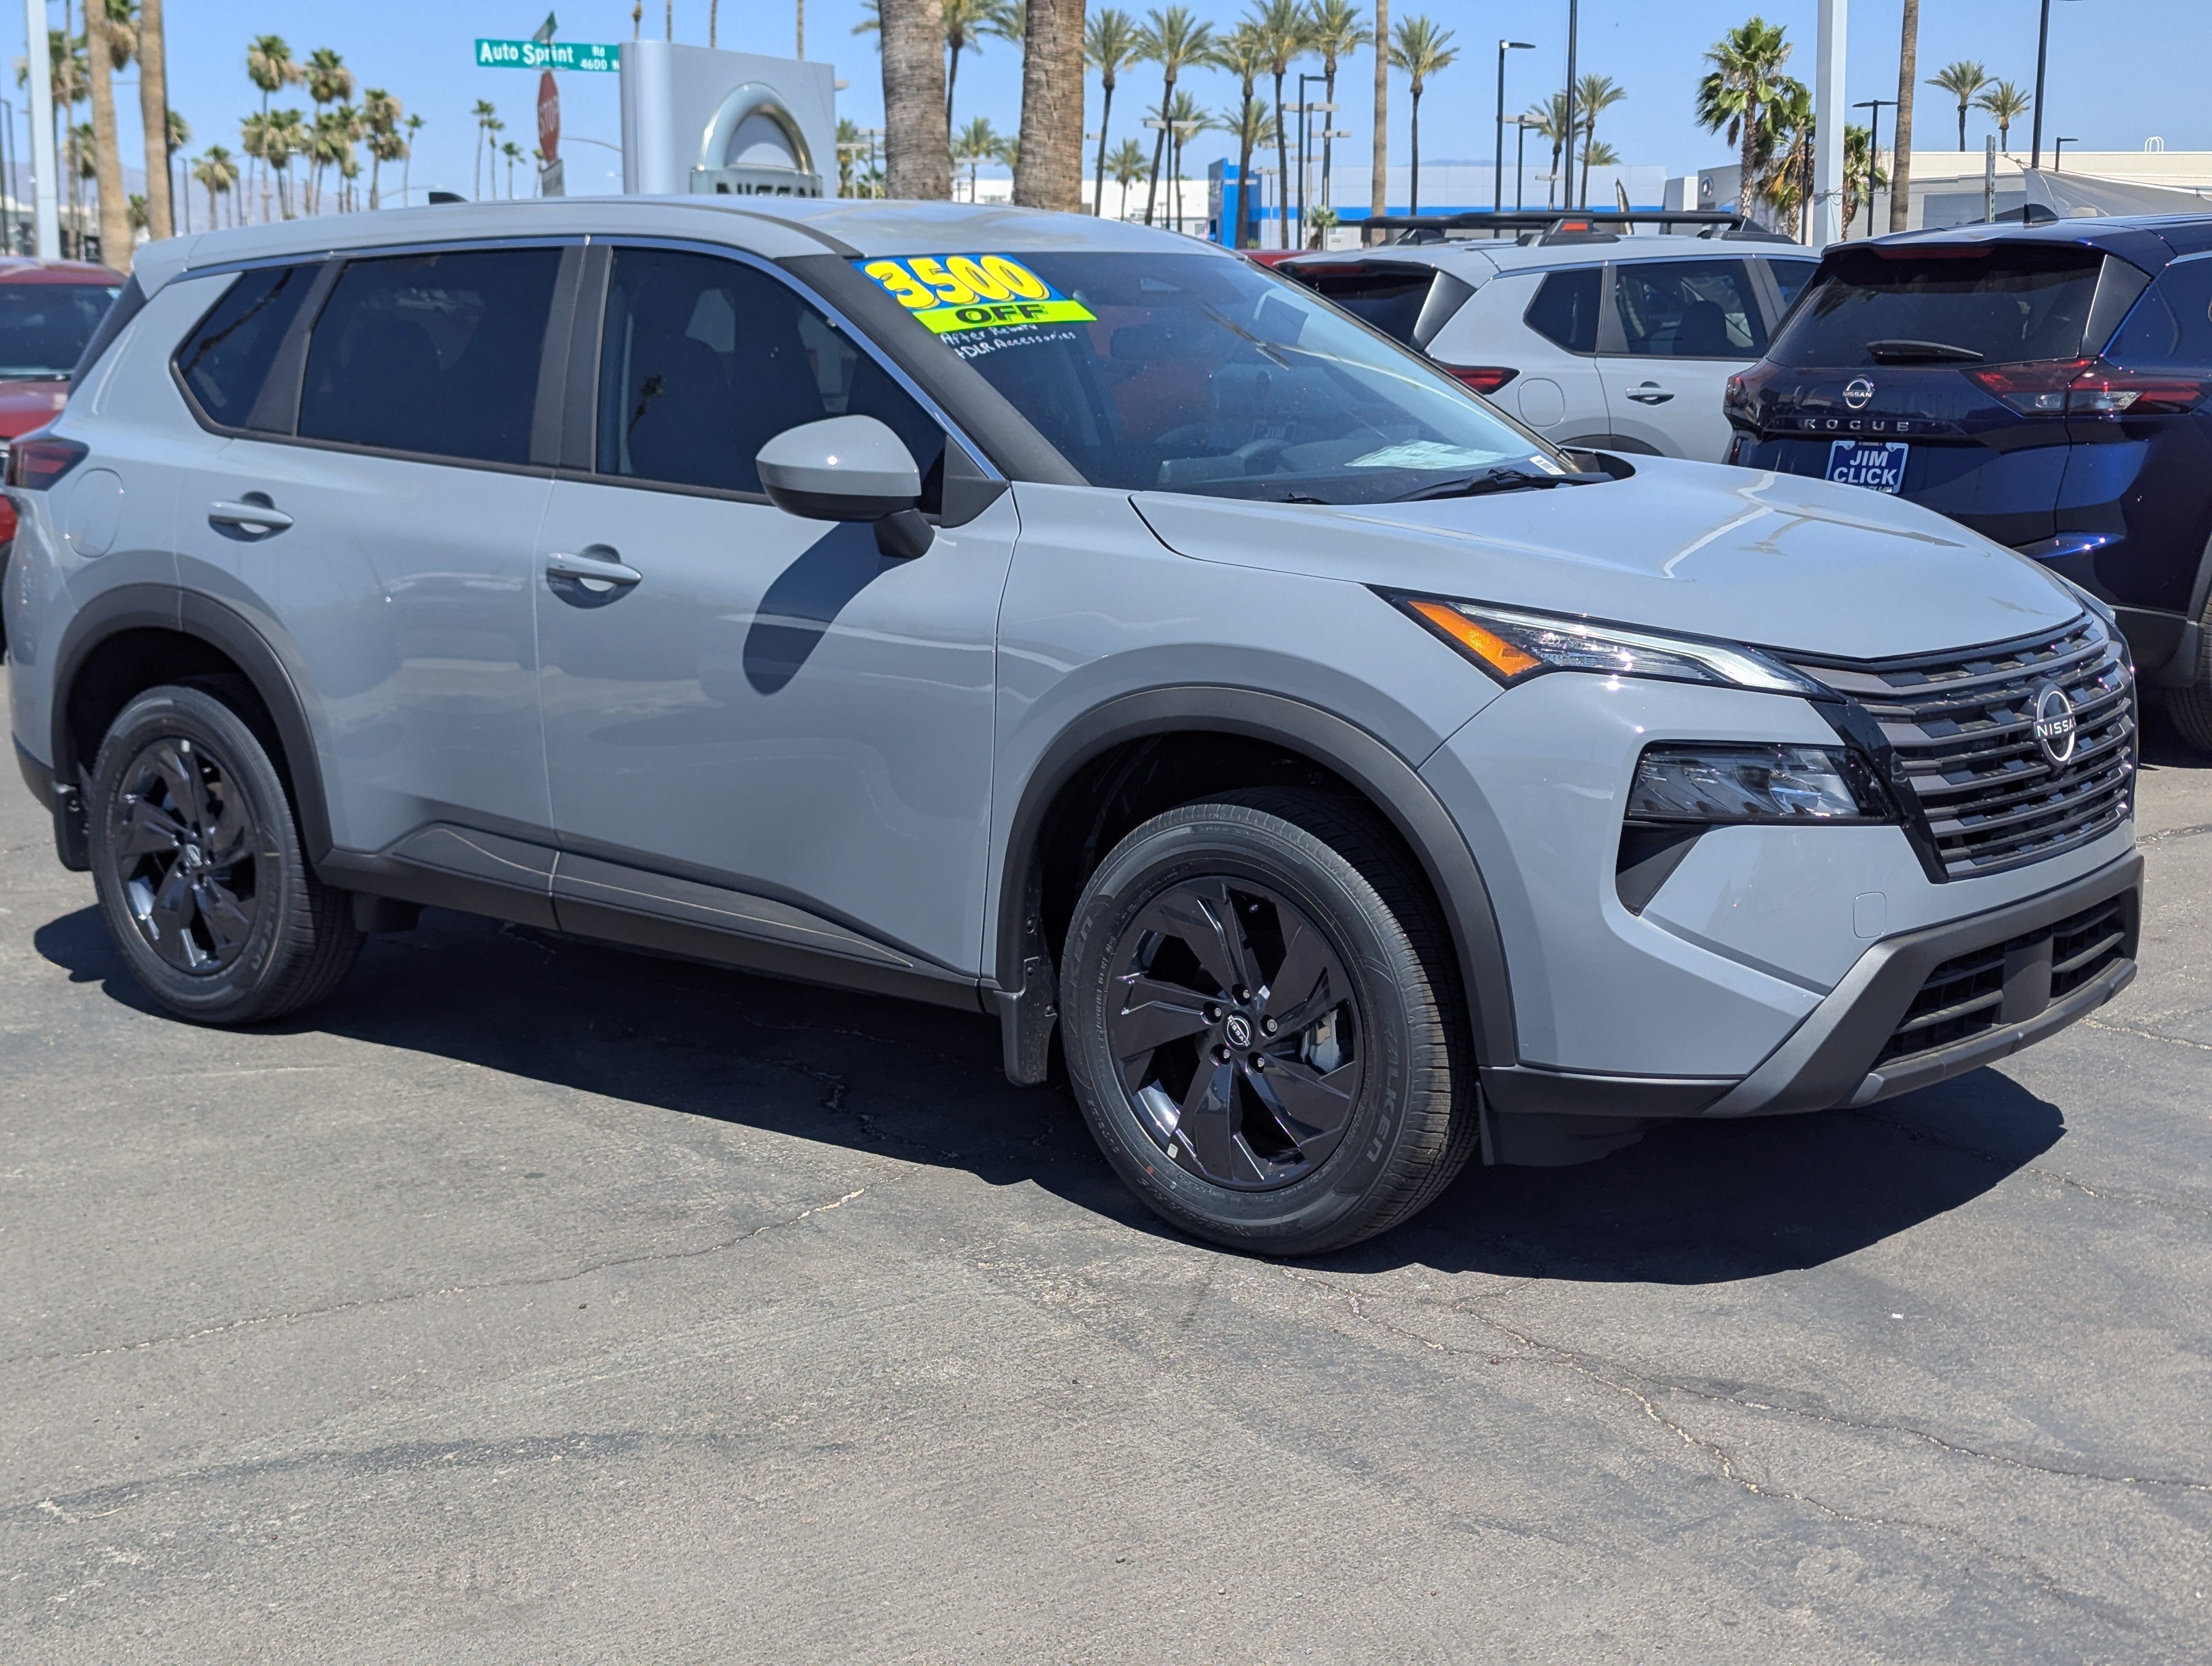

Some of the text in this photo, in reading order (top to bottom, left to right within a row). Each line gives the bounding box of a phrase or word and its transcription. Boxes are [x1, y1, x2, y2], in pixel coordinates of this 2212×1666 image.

[480, 41, 606, 65] Auto Sprint Rd
[581, 58, 608, 70] 4600
[865, 255, 1050, 309] 3500
[955, 303, 1048, 325] OFF
[940, 330, 985, 345] After
[994, 331, 1076, 349] Accessories
[1805, 419, 1909, 432] ROGUE
[1850, 450, 1889, 467] JIM
[1833, 467, 1898, 485] CLICK
[1227, 1015, 1251, 1048] NISSAN
